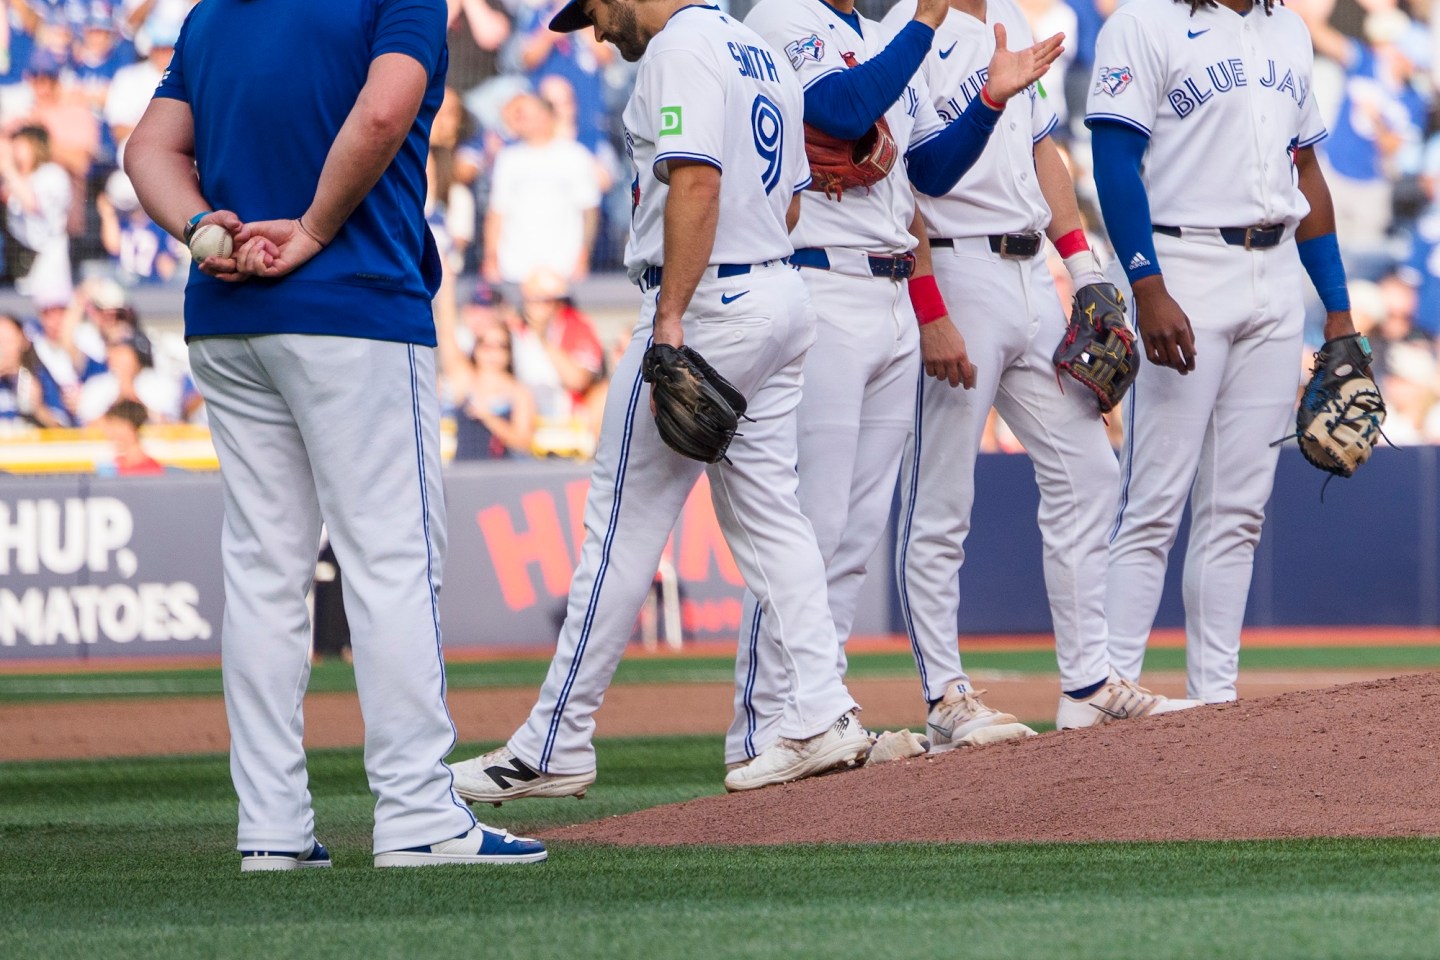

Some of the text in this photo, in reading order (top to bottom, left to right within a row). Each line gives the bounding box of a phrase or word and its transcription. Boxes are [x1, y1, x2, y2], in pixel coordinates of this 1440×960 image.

[726, 41, 780, 83] SMITH
[1167, 58, 1248, 120] BLUE
[751, 93, 784, 197] 9
